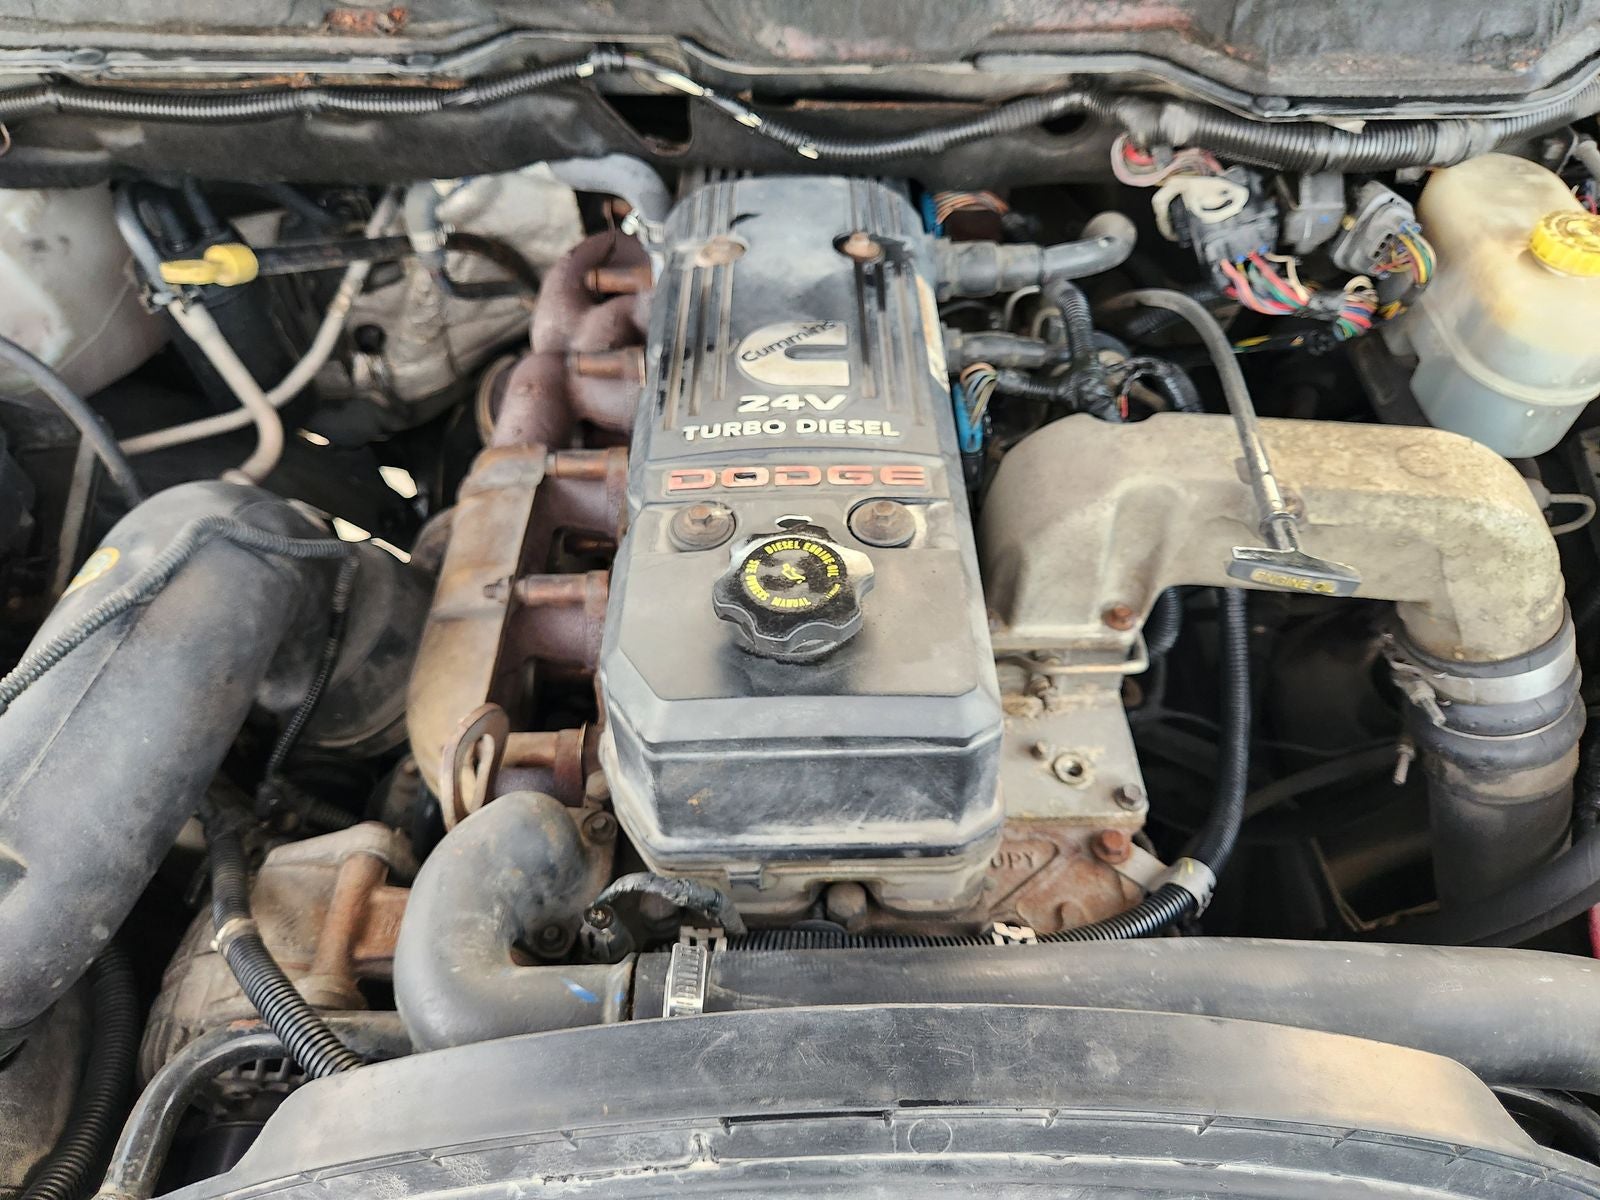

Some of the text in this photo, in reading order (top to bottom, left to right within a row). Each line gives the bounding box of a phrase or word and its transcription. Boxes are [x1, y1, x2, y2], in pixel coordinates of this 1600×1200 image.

[741, 319, 837, 362] Cummins
[737, 393, 848, 413] 24V
[682, 418, 900, 441] TURBO DIESEL
[669, 465, 926, 490] DODGE
[764, 540, 800, 555] DIESEL
[1253, 571, 1311, 590] ENGINE
[771, 596, 812, 608] MANUAL
